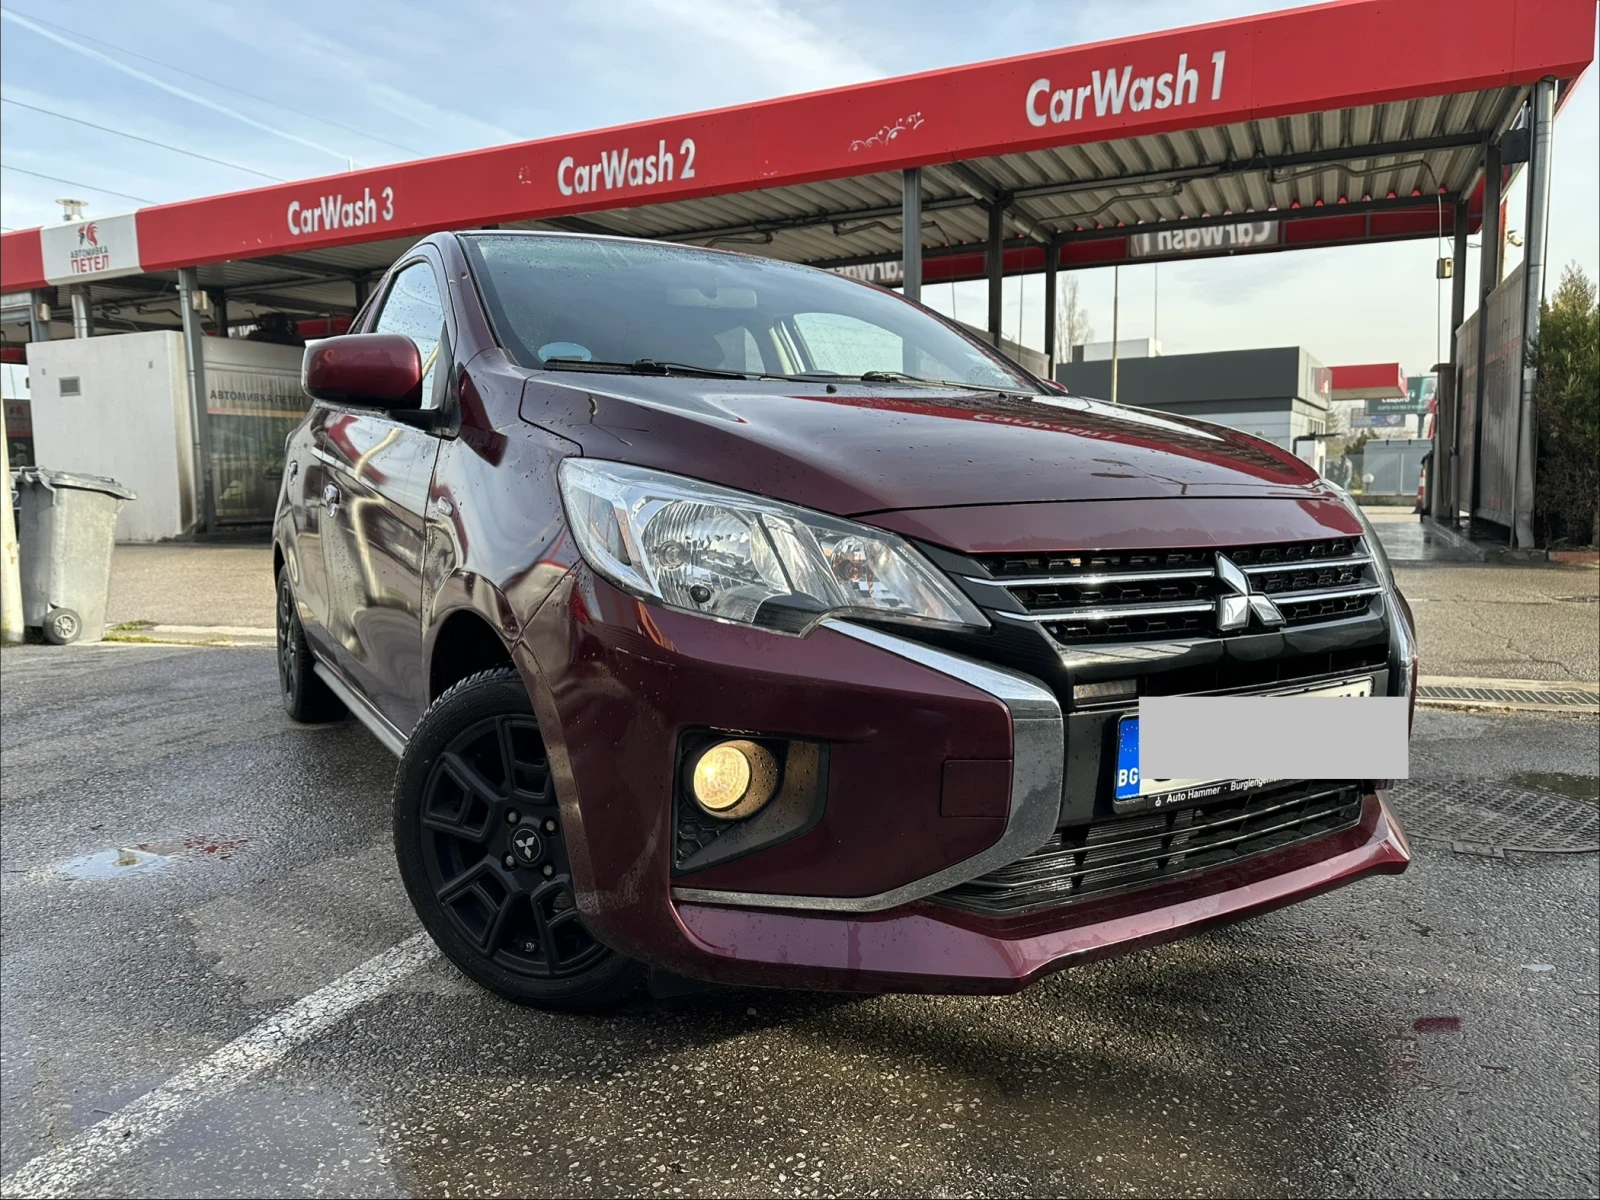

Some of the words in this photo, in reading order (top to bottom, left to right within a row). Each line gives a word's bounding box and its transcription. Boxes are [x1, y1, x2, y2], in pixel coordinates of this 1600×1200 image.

[1025, 53, 1198, 127] CarWash
[1211, 50, 1226, 101] 1
[557, 140, 674, 196] CarWash
[679, 138, 696, 179] 2
[287, 187, 377, 235] CarWash
[381, 186, 394, 221] 3
[71, 255, 109, 274] ПЕТЕЛ
[210, 390, 273, 403] АВТОМИВКА
[275, 395, 304, 405] ПЕТЕЛ
[1118, 767, 1139, 787] BG
[1166, 793, 1186, 804] Auto
[1187, 786, 1221, 800] Hammer
